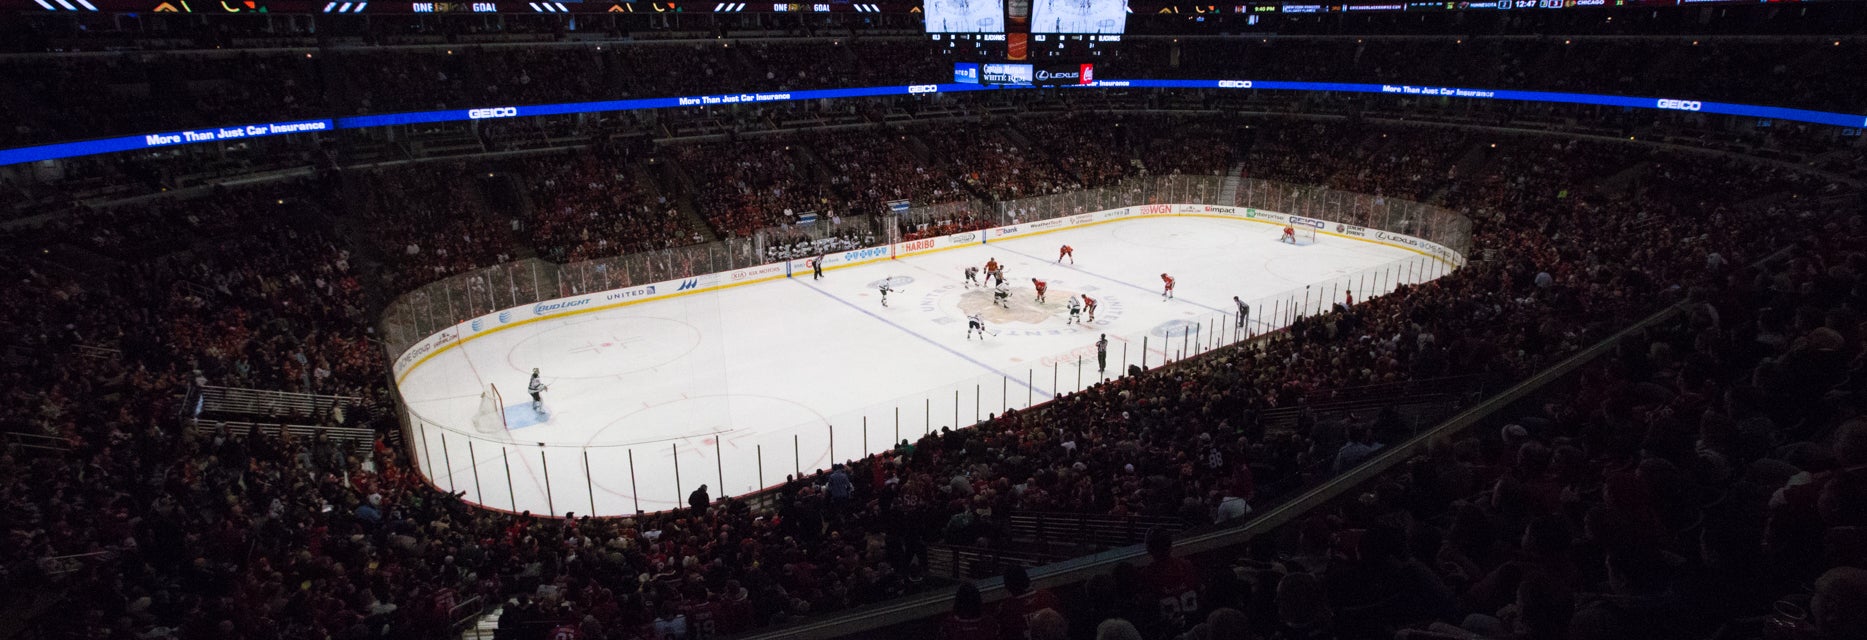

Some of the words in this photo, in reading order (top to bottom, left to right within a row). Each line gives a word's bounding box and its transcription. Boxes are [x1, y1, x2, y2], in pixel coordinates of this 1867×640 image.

[413, 3, 433, 12] ONE
[473, 3, 497, 12] GOAL
[774, 4, 788, 12] ONE
[814, 4, 830, 12] GOAL
[1218, 80, 1252, 88] GEICO
[908, 85, 937, 93] GEICO
[1456, 89, 1494, 97] Insurance
[722, 95, 739, 103] Just
[741, 94, 754, 102] Car
[756, 93, 790, 101] Insurance
[1657, 99, 1701, 111] GEICO
[469, 107, 516, 119] GEICO
[146, 134, 181, 146] More
[183, 131, 214, 142] Than
[217, 128, 244, 139] Just
[246, 125, 267, 135] Car
[270, 121, 326, 133] Insurance
[1149, 204, 1172, 214] WGN
[1210, 206, 1235, 214] impact
[1004, 226, 1018, 235] bank
[1387, 235, 1418, 246] LEXUS
[905, 239, 935, 252] HARIBO
[607, 289, 645, 301] UNITED
